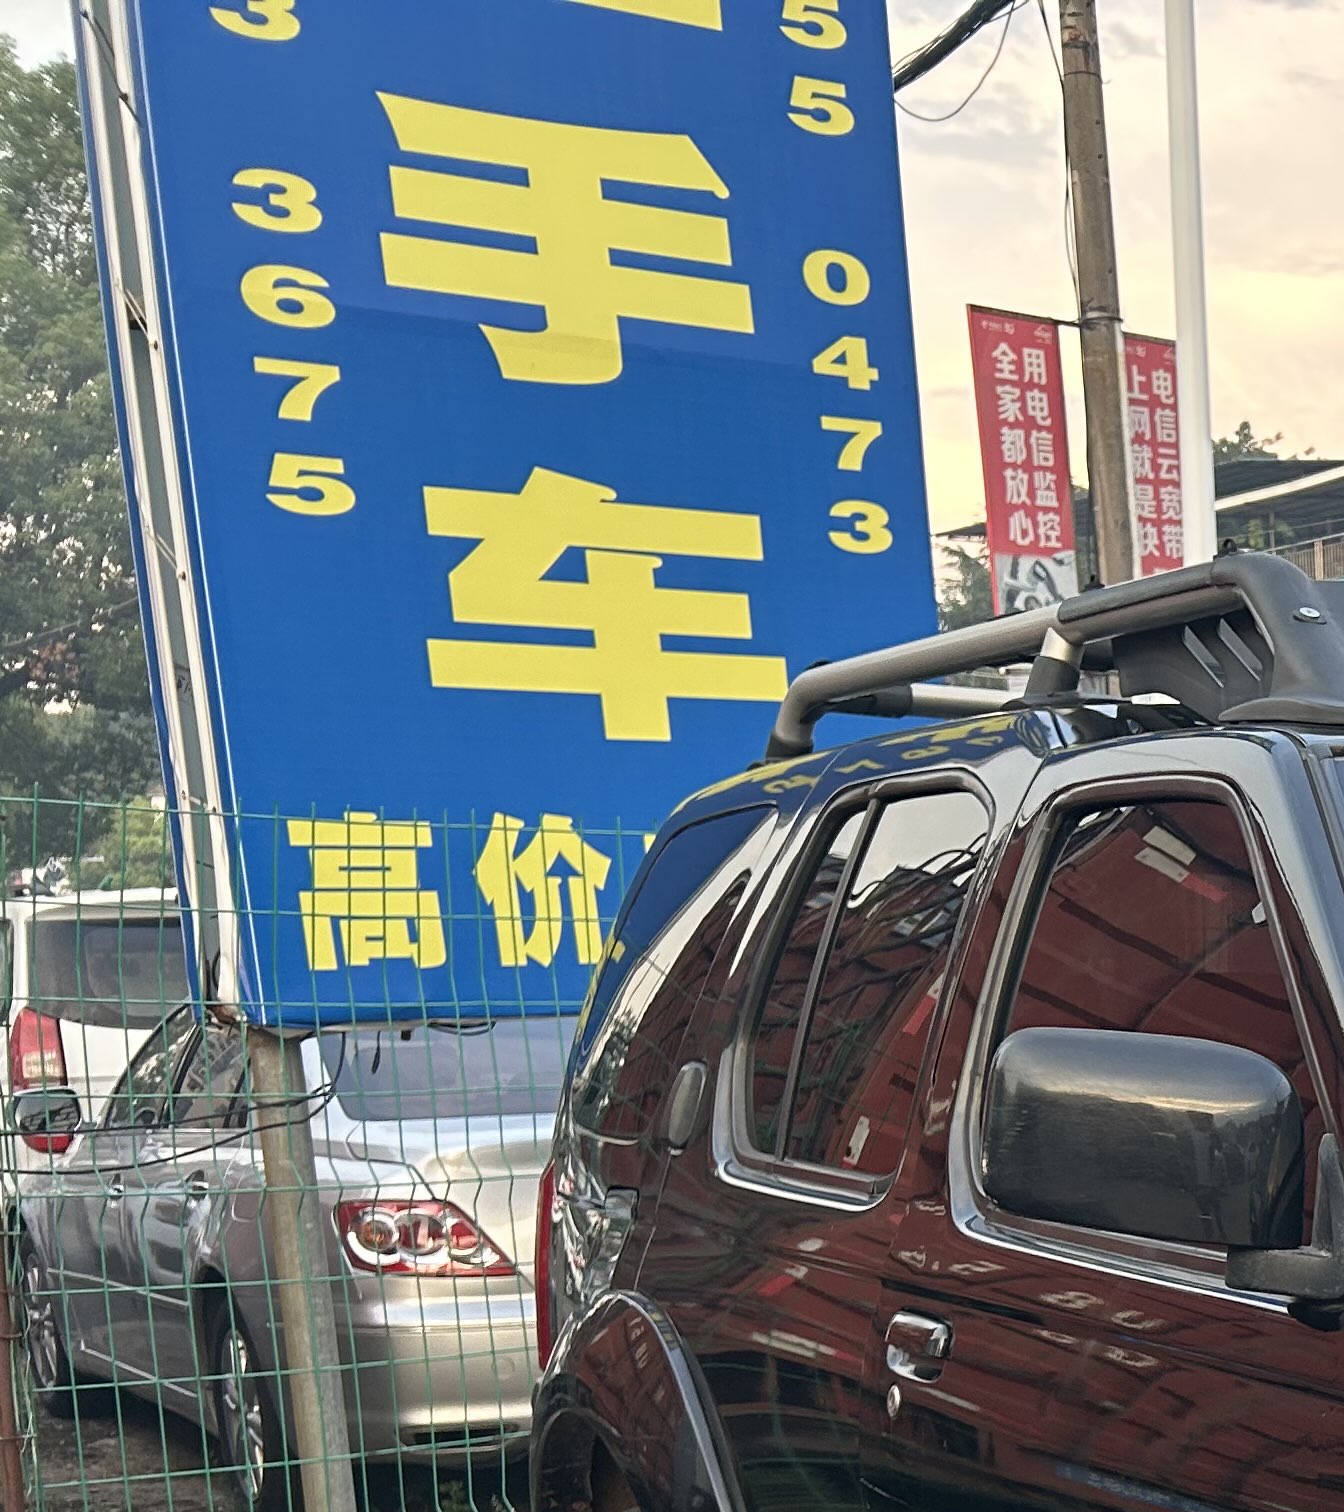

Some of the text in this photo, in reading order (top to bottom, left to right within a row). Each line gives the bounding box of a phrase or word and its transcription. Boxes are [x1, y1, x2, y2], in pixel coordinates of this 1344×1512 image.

[231, 168, 357, 517] 3675
[803, 249, 893, 555] 0473
[991, 342, 1035, 547] 全家都放心
[1021, 346, 1063, 549] 用电信监控
[287, 812, 657, 972] 高价
